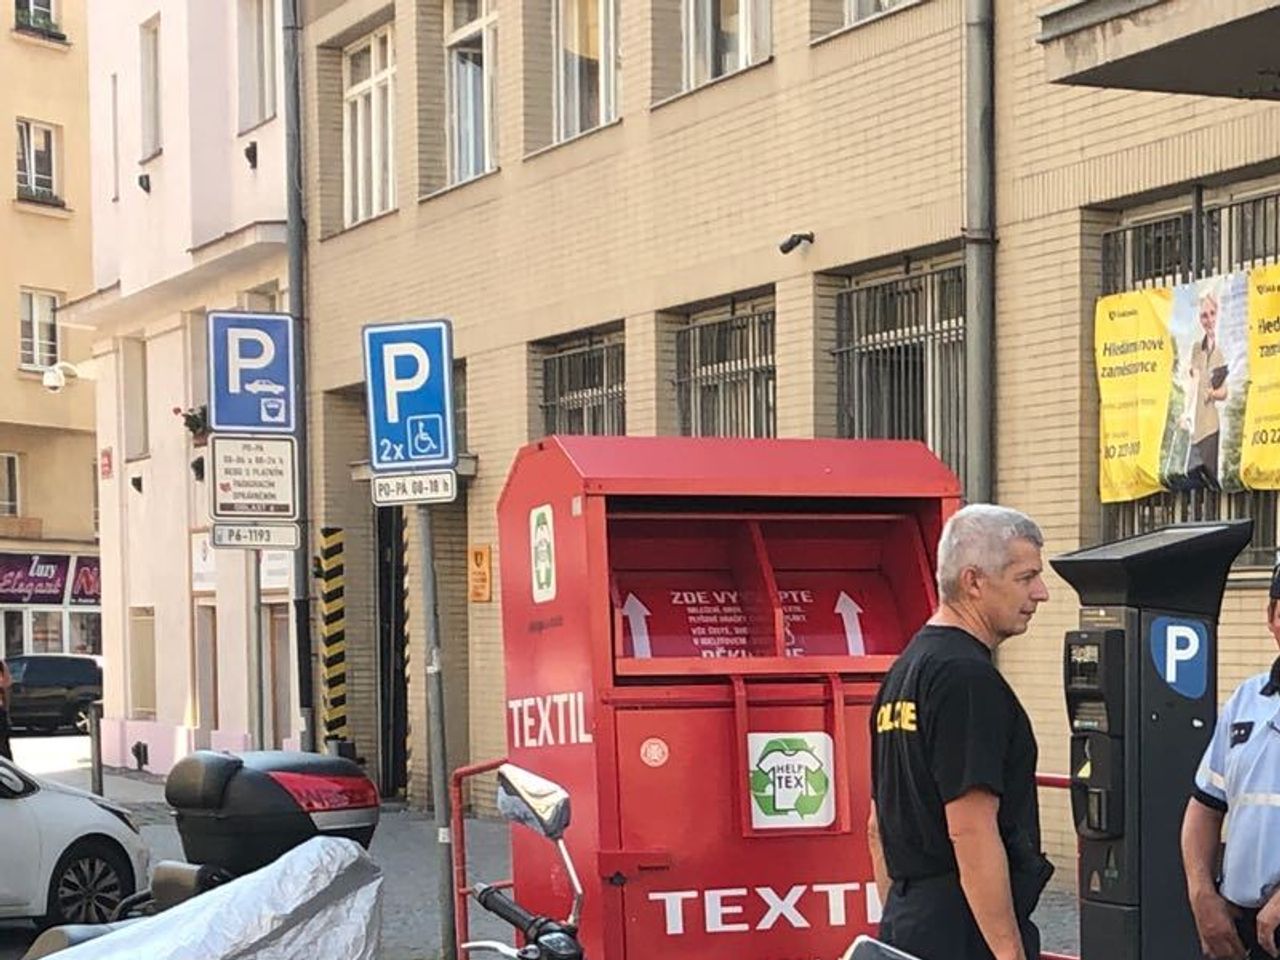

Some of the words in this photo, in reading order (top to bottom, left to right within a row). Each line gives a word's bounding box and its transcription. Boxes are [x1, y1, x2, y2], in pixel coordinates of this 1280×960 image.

[227, 327, 275, 394] P
[382, 341, 430, 424] P
[380, 439, 405, 461] 2x
[378, 480, 407, 498] PO-PÁ
[444, 480, 449, 493] h
[228, 529, 270, 542] P6-1193
[670, 591, 711, 605] ZDE
[1165, 625, 1200, 683] P
[508, 691, 593, 748] TEXTIL
[776, 764, 804, 775] HELP
[777, 775, 804, 790] TEX
[648, 882, 883, 935] TEXTI
